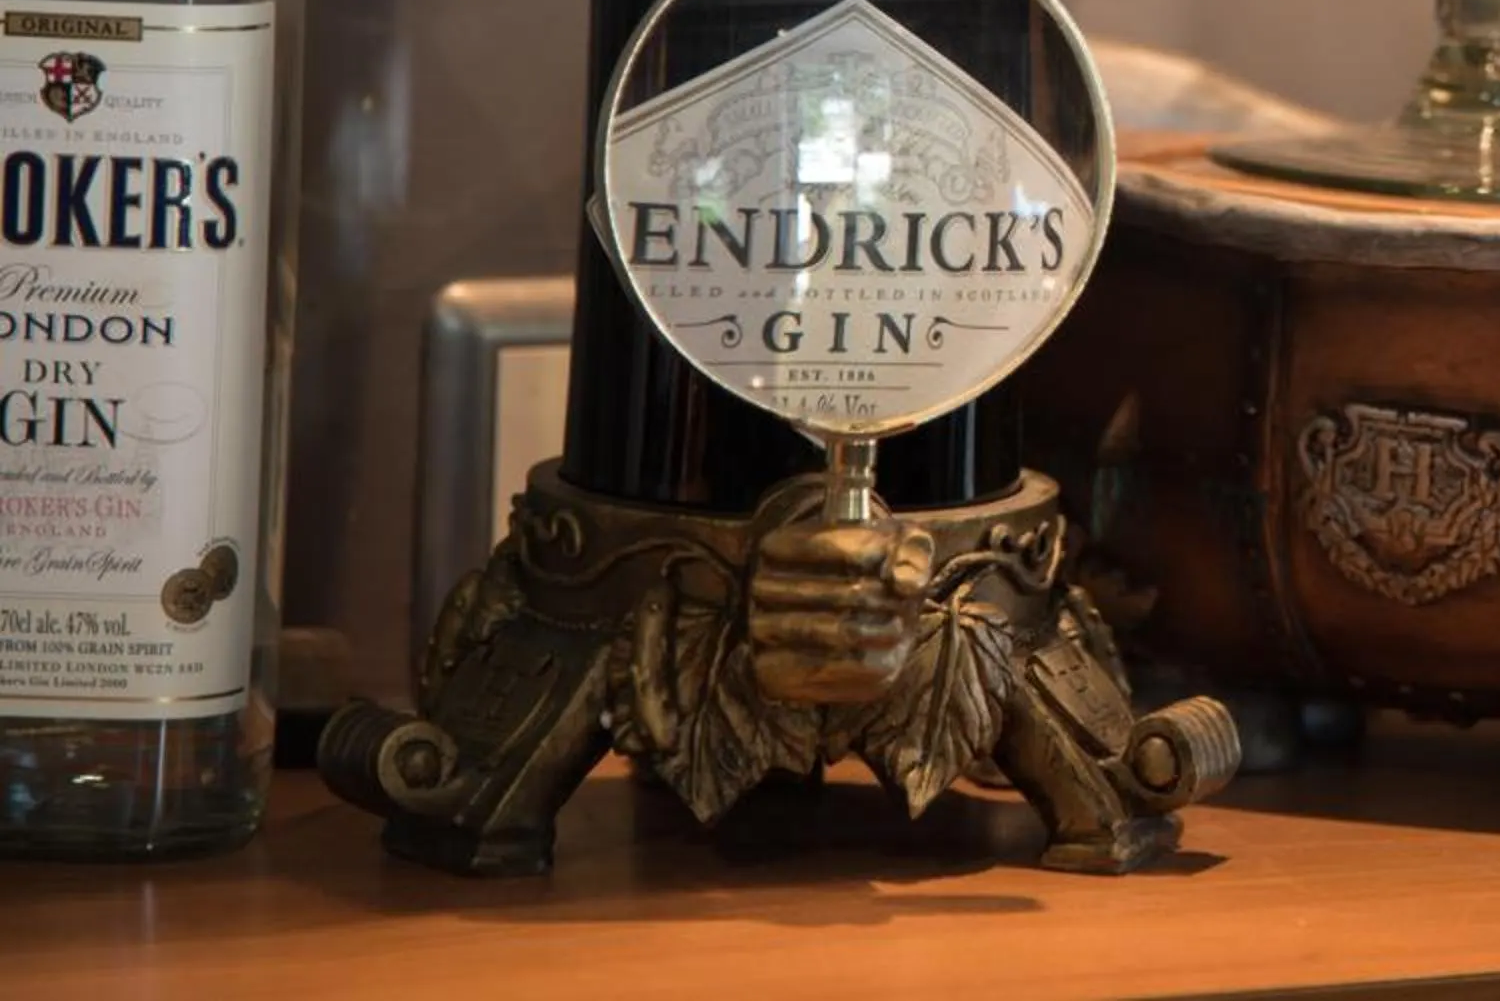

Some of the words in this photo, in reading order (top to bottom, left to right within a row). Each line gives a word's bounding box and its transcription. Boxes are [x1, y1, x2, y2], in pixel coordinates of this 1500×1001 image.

[21, 16, 129, 36] ORIGINAL
[93, 130, 183, 145] ENGLAND
[628, 202, 1064, 275] ENDRICK'S
[0, 262, 138, 305] Premium
[918, 288, 943, 301] IN
[762, 310, 916, 355] GIN
[24, 359, 102, 386] DRY
[788, 368, 829, 383] EST.
[838, 369, 876, 383] 1886
[0, 389, 127, 449] GIN
[6, 523, 107, 538] ENGLAND
[1, 608, 32, 634] 70cl
[77, 642, 125, 657] GRAIN
[127, 642, 174, 657] SPIRIT
[66, 660, 129, 675] LONDON
